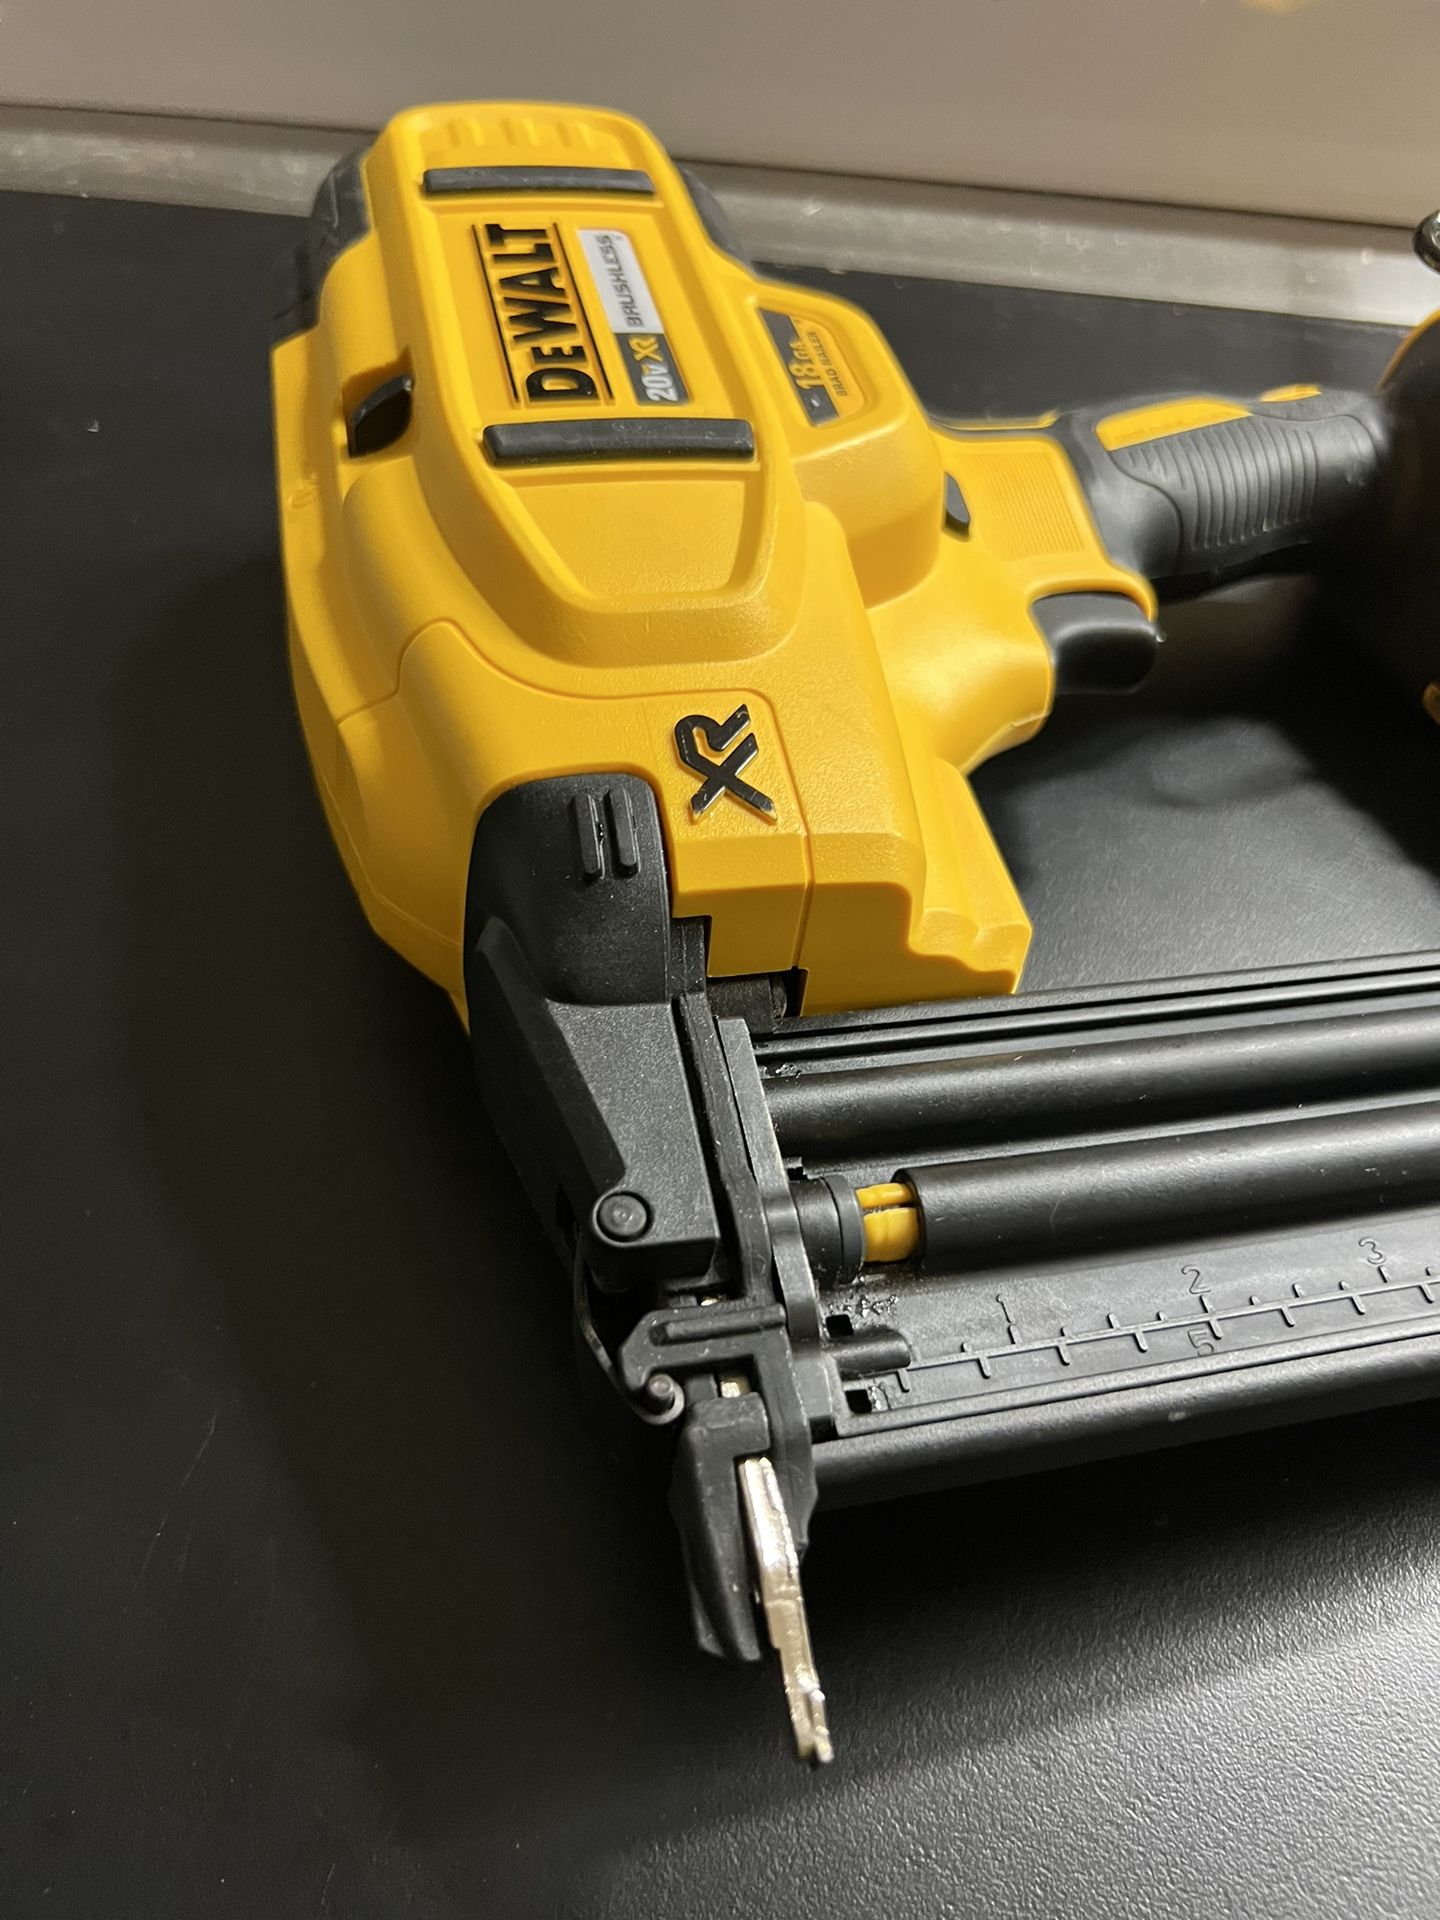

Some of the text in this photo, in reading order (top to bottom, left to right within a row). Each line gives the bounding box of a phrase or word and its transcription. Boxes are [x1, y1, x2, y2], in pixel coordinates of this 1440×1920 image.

[484, 223, 601, 402] DEWALT
[596, 234, 645, 329] BRUSHLESS
[628, 335, 664, 363] XR
[788, 362, 825, 390] 18
[806, 331, 849, 397] BRAD NAILER
[674, 703, 778, 822] XR
[995, 1236, 1387, 1324] 1 2 3
[1187, 1328, 1215, 1357] 5
